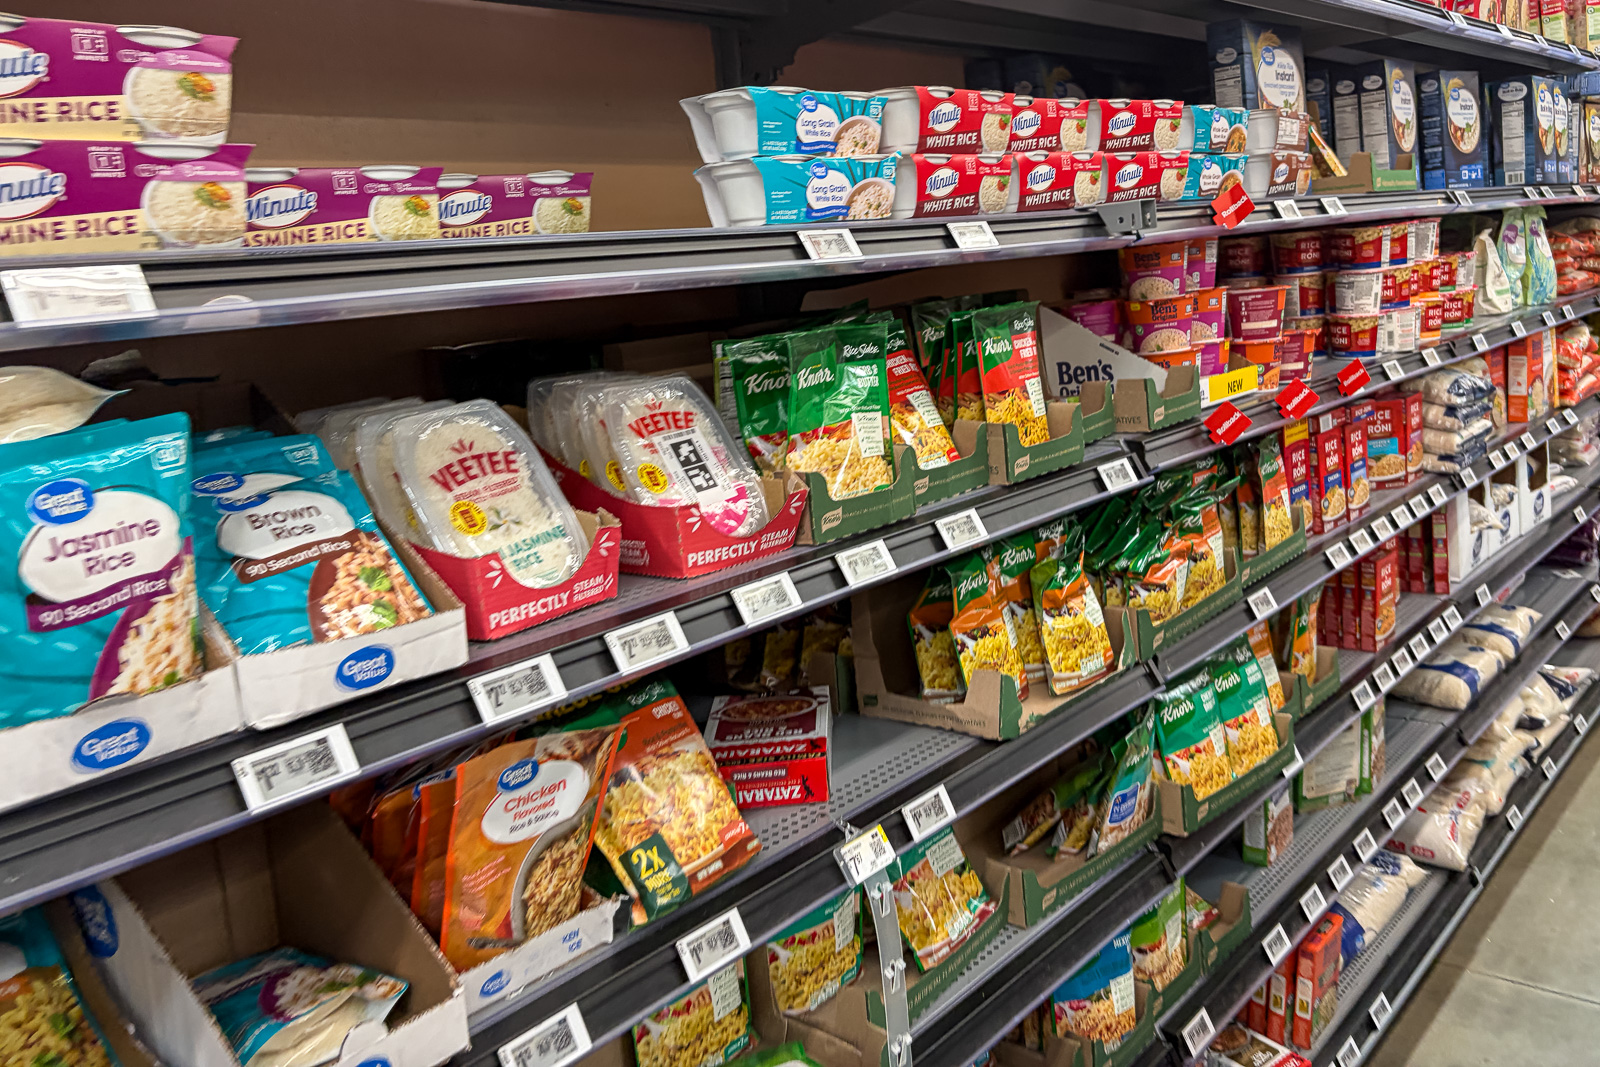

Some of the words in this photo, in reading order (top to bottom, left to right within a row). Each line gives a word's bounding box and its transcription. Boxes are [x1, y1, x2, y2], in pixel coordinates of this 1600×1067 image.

[1275, 70, 1295, 82] Instant
[801, 119, 817, 129] Long
[818, 118, 836, 128] Grain
[928, 102, 962, 129] Minute
[1012, 110, 1041, 134] Minute
[1108, 113, 1137, 134] Minute
[926, 133, 957, 148] WHITE
[957, 132, 978, 145] RICE
[1011, 137, 1037, 151] WHITE
[1038, 136, 1057, 148] RICE
[1106, 137, 1133, 149] WHITE
[1134, 134, 1150, 146] RICE
[925, 168, 960, 196] Minute
[1027, 164, 1057, 190] Minute
[1115, 166, 1143, 186] Minute
[811, 184, 828, 194] Long
[829, 184, 848, 194] Grain
[830, 194, 843, 202] Rice
[1025, 191, 1051, 206] WHITE
[1051, 188, 1071, 202] RICE
[1113, 187, 1140, 201] WHITE
[1140, 184, 1157, 197] RICE
[1268, 183, 1283, 195] BROWN
[1283, 182, 1296, 193] RICE
[439, 194, 493, 220] Minute
[923, 199, 953, 213] WHITE
[953, 194, 976, 208] RICE
[1221, 195, 1248, 218] Rollback
[75, 215, 137, 237] RICE
[323, 222, 366, 241] RICE
[496, 221, 530, 238] RICE
[1301, 241, 1320, 249] RICE
[1151, 304, 1177, 314] Ben's
[1444, 301, 1461, 309] RICE
[1152, 313, 1178, 321] Original
[983, 336, 1013, 356] Knorr
[797, 366, 835, 390] Knorr
[1056, 358, 1114, 386] Ben's
[1343, 367, 1364, 387] Rollback
[744, 371, 791, 395] Knor
[1227, 378, 1243, 394] NEW
[1285, 387, 1310, 412] Rollback
[1410, 402, 1419, 413] RICE
[628, 411, 695, 439] VEETEE
[1216, 411, 1241, 436] Rollback
[1325, 440, 1338, 453] RICE
[1350, 430, 1362, 443] RICE
[1291, 449, 1305, 463] RICE
[429, 451, 521, 492] VEETEE
[246, 504, 322, 531] Brown
[44, 519, 161, 563] Jasmine
[270, 523, 316, 542] Rice
[508, 524, 567, 556] JASMINE
[761, 528, 788, 543] STEAM
[82, 551, 136, 578] Rice
[246, 562, 268, 577] 90
[267, 545, 320, 571] Second
[319, 540, 352, 554] Rice
[512, 551, 543, 572] RICE
[688, 540, 758, 569] PERFECTLY
[1001, 547, 1035, 567] Knorr
[573, 574, 605, 594] STEAM
[38, 608, 64, 627] 90
[64, 585, 132, 622] Second
[131, 578, 168, 597] Rice
[489, 590, 569, 630] PERFECTLY
[342, 652, 387, 677] Great
[353, 665, 388, 684] Value
[1214, 672, 1241, 692] Knorr
[1161, 699, 1195, 725] Knorr
[81, 727, 139, 756] Great
[96, 742, 140, 763] Value
[502, 763, 533, 783] Great
[753, 770, 773, 779] BEANS
[774, 769, 786, 777] RED
[504, 778, 567, 813] Chicken
[513, 796, 556, 822] Flavored
[509, 823, 527, 835] Rice
[644, 867, 673, 892] MORE
